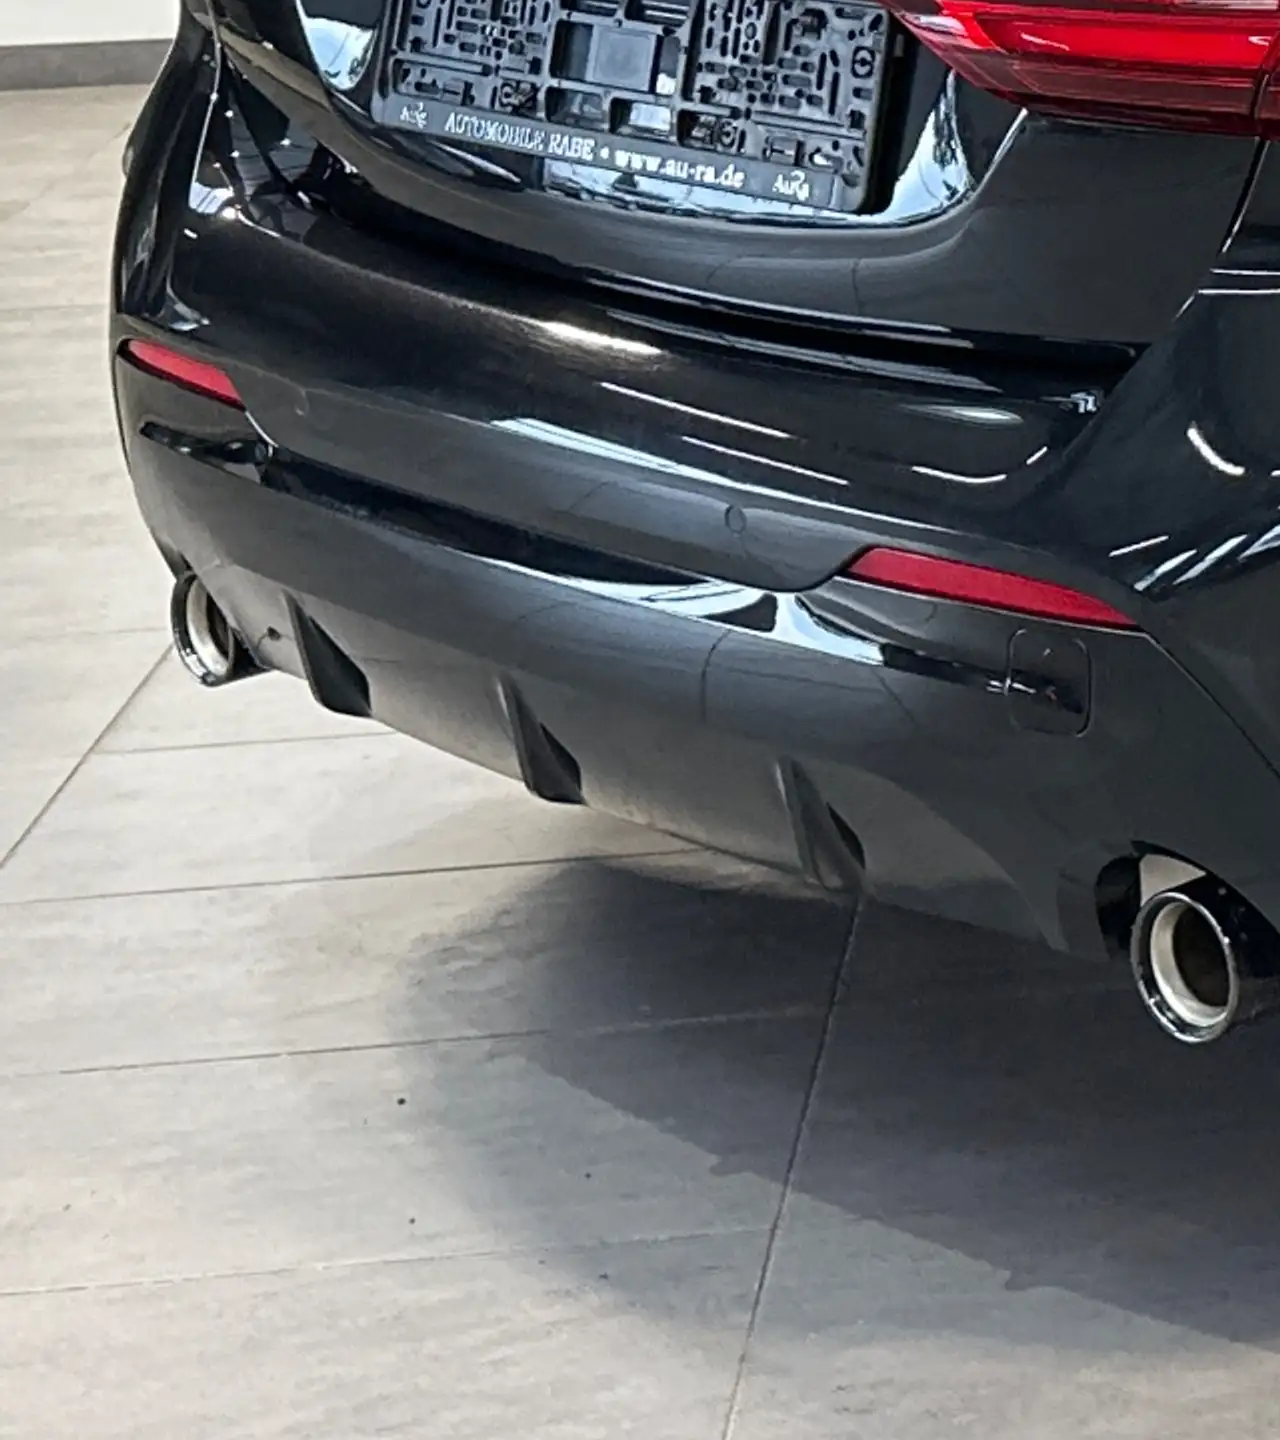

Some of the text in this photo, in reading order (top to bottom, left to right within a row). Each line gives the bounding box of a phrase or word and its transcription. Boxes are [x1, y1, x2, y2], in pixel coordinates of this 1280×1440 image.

[444, 112, 544, 151] AUTOMOBILE
[548, 132, 596, 161] RABE
[614, 149, 746, 189] www.au-ra.de
